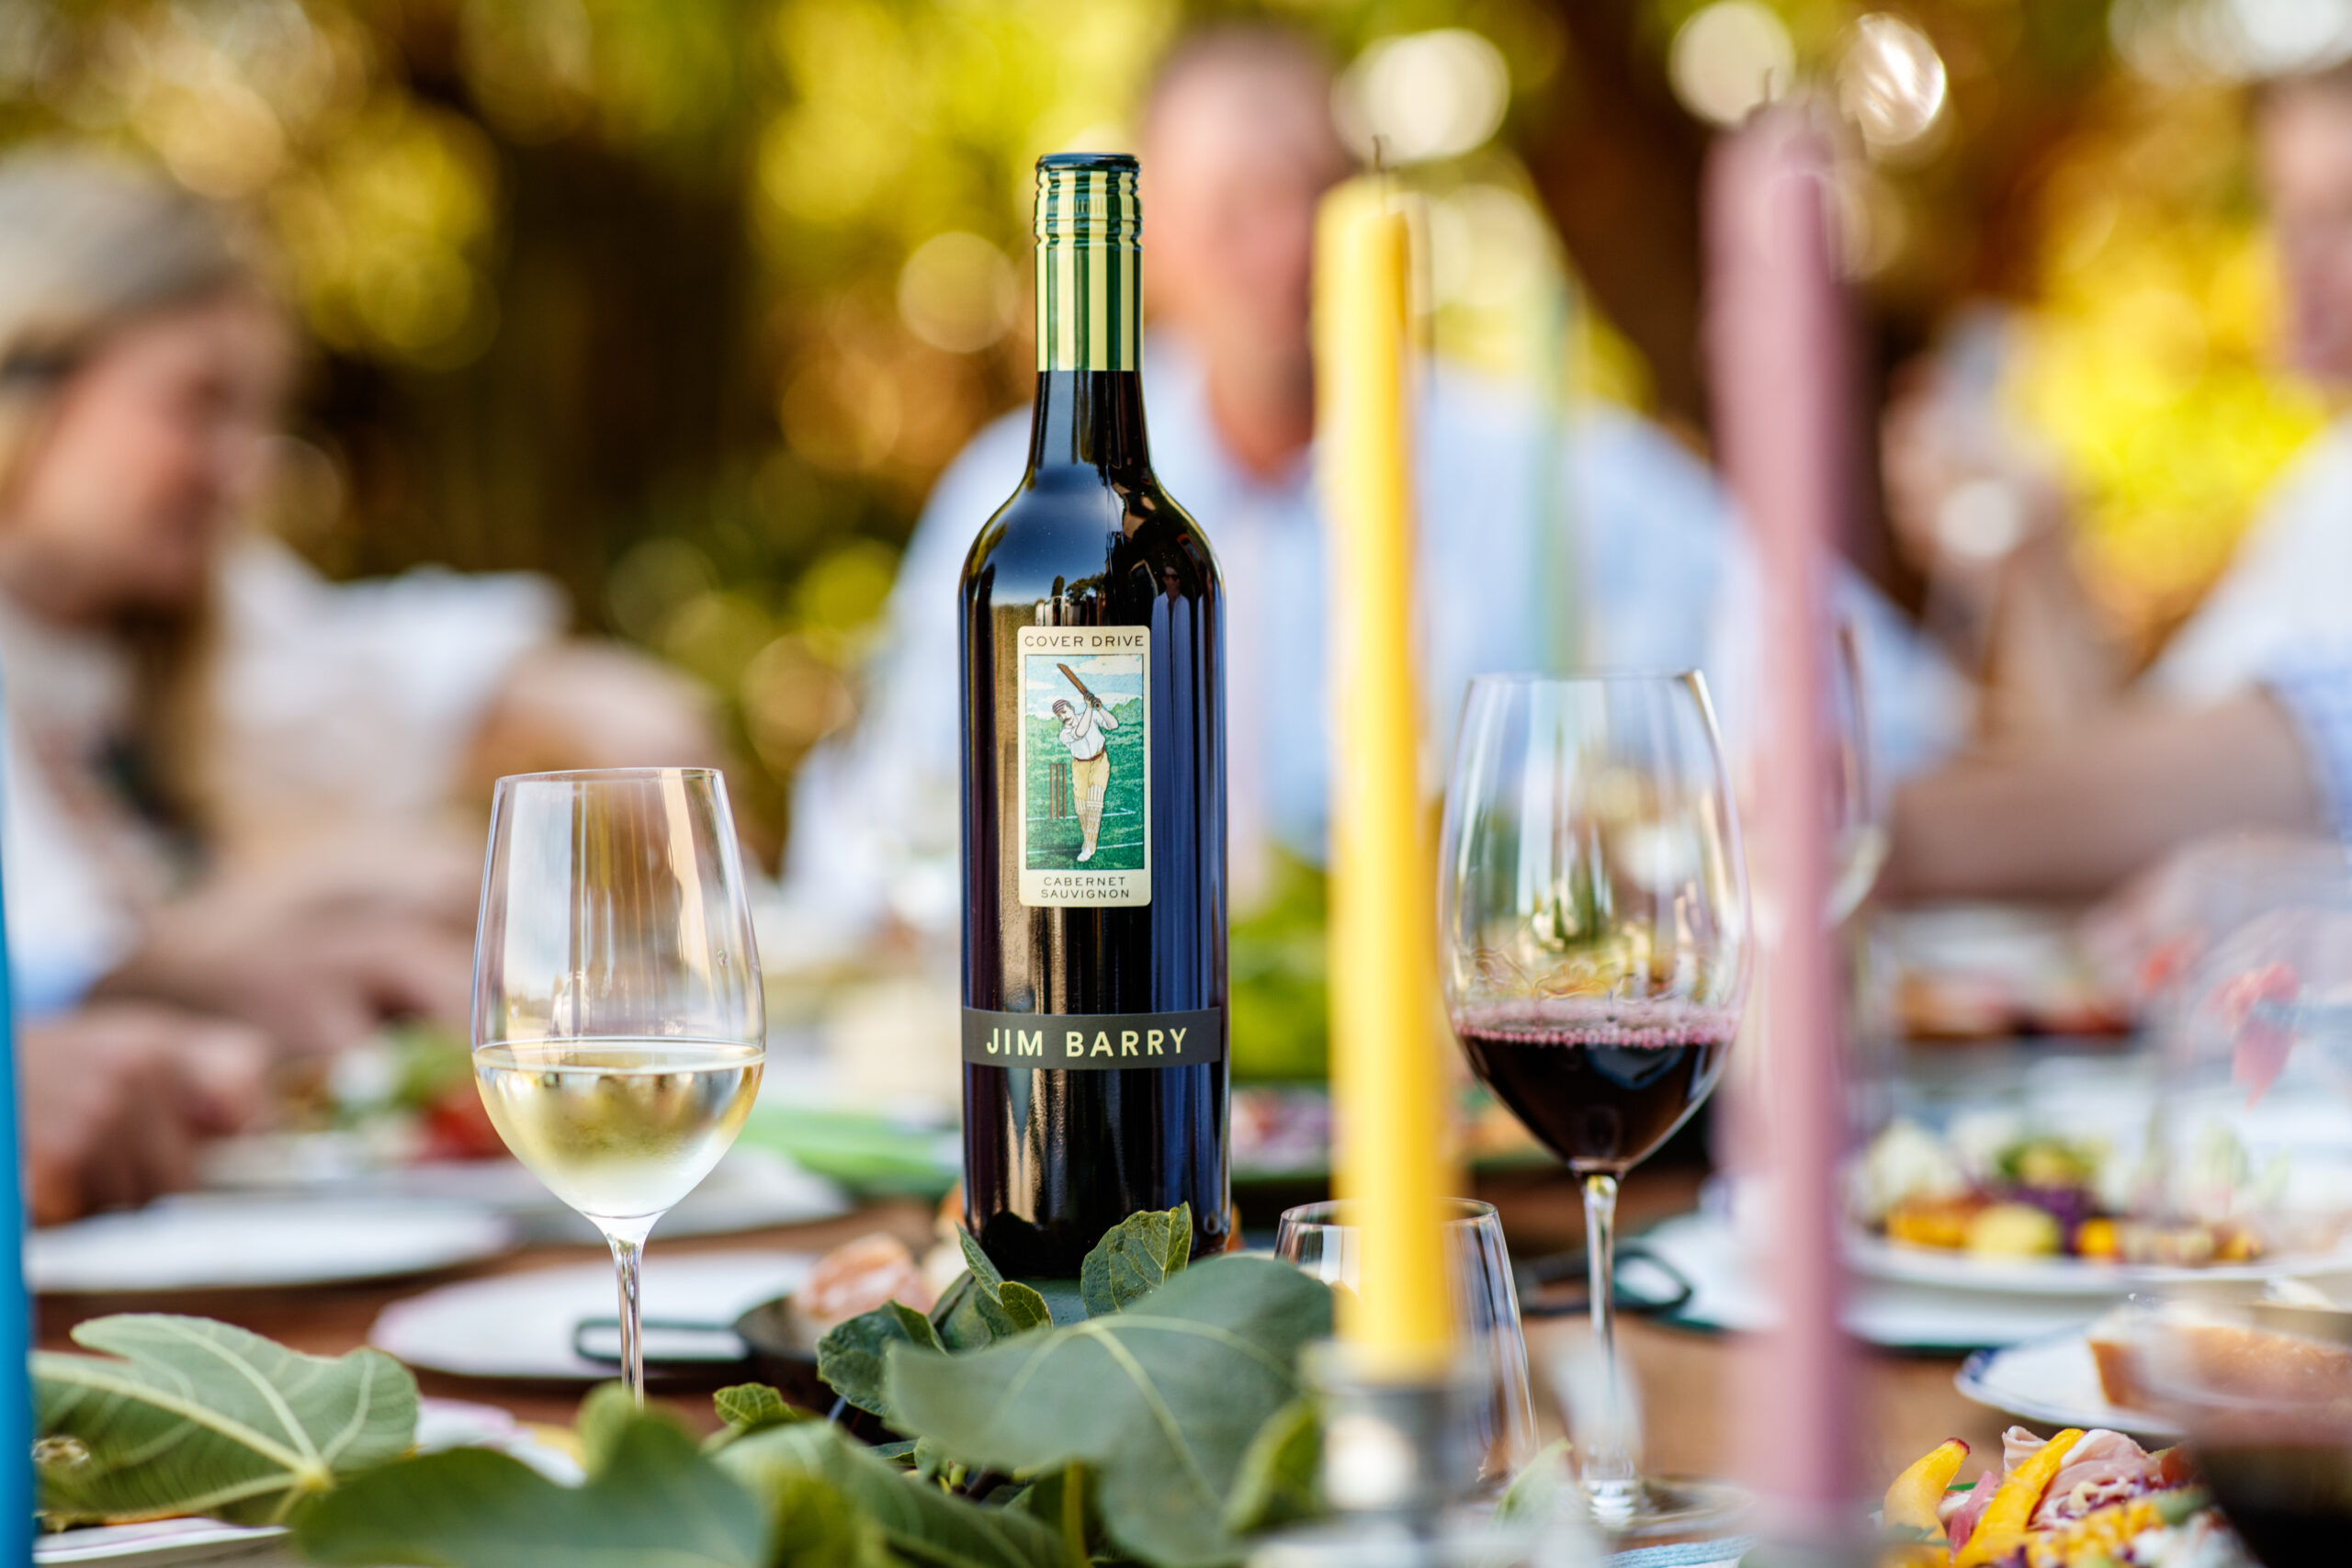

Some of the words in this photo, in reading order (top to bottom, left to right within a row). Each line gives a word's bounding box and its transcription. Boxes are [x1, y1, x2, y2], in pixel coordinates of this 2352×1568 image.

[1024, 636, 1084, 648] COVER
[1091, 635, 1145, 647] DRIVE
[1043, 876, 1126, 886] CABERNET
[1040, 888, 1130, 898] SAUVIGNON
[986, 1027, 1043, 1056] JIM
[1066, 1027, 1188, 1057] BARRY
